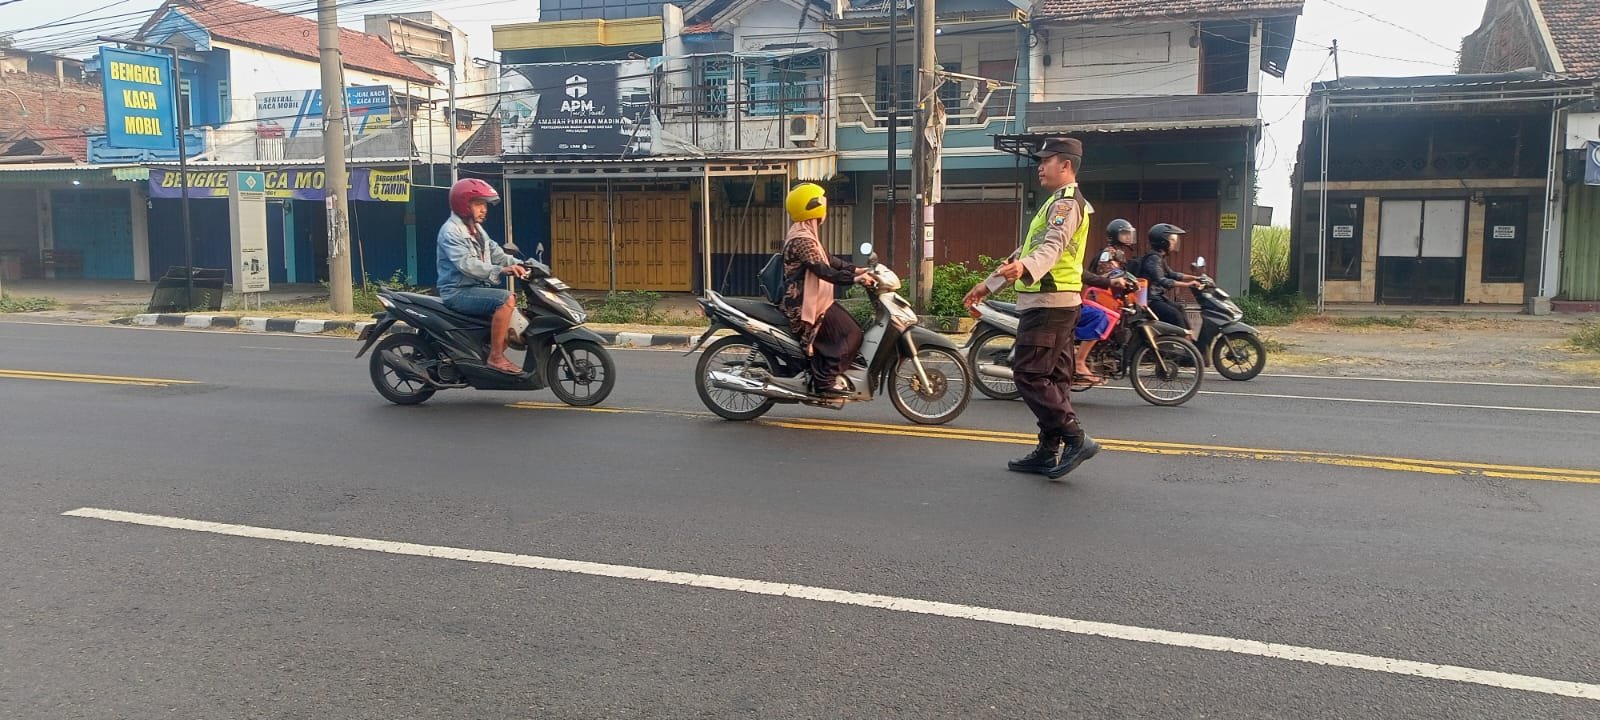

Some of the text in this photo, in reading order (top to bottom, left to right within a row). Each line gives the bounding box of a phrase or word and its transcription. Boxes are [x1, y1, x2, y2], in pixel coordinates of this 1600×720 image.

[110, 61, 162, 85] BENGKEL
[123, 89, 157, 110] KACA
[263, 95, 293, 103] SENTRAL
[277, 101, 299, 109] MOBIL
[560, 99, 593, 112] APM
[124, 116, 163, 136] MOBIL
[161, 171, 229, 188] BENGKE
[374, 183, 407, 195] 5 TAHUN
